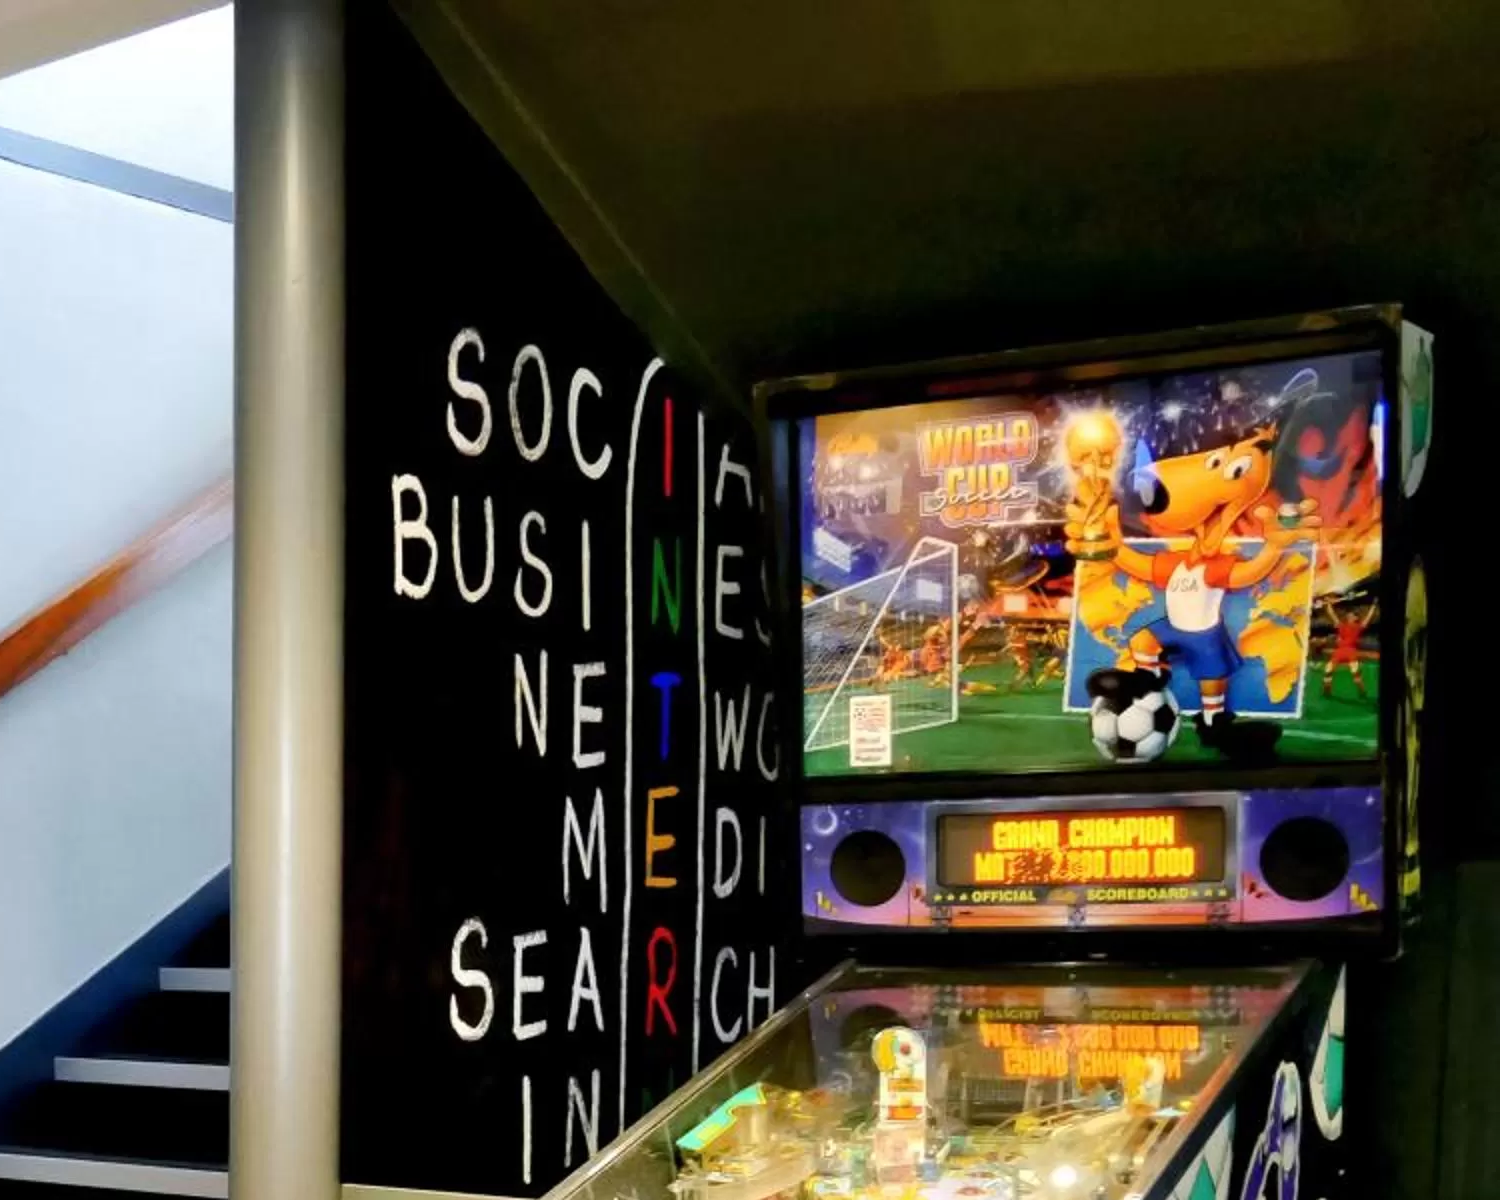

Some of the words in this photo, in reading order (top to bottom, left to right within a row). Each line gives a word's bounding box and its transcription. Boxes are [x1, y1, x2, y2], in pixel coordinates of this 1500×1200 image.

[922, 418, 1031, 466] WORLD
[946, 463, 1011, 519] CUP
[1170, 577, 1199, 592] USA
[993, 820, 1059, 850] GRAND
[1069, 815, 1176, 848] CHAMPION
[971, 889, 1037, 902] OFFICIAL
[1086, 887, 1190, 901] SCOREBOARD
[449, 915, 775, 1042] SEARCH
